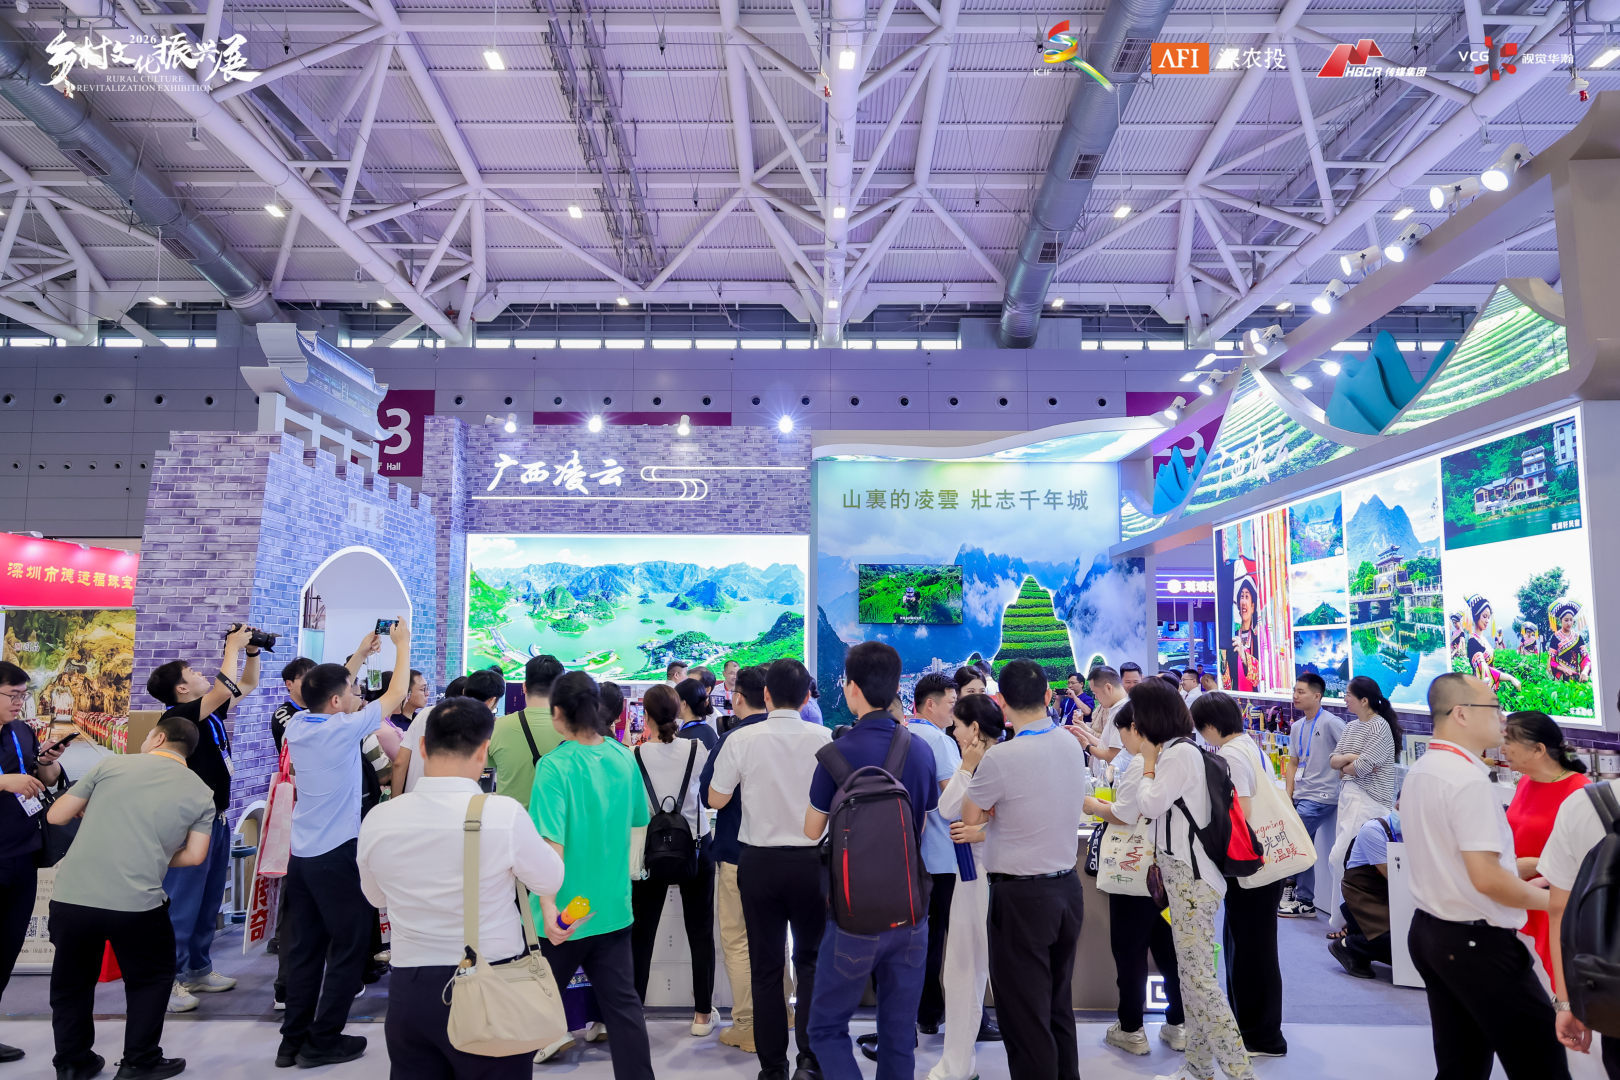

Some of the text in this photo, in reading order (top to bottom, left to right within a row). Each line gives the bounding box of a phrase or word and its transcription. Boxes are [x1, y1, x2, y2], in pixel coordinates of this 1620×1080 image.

[383, 408, 411, 454] 3
[386, 462, 401, 471] Hall
[487, 450, 625, 495] 广西凌云
[842, 488, 1089, 510] 山裏的凌雲 壯志千年城
[224, 679, 239, 693] SONY
[1264, 831, 1290, 856] 光明
